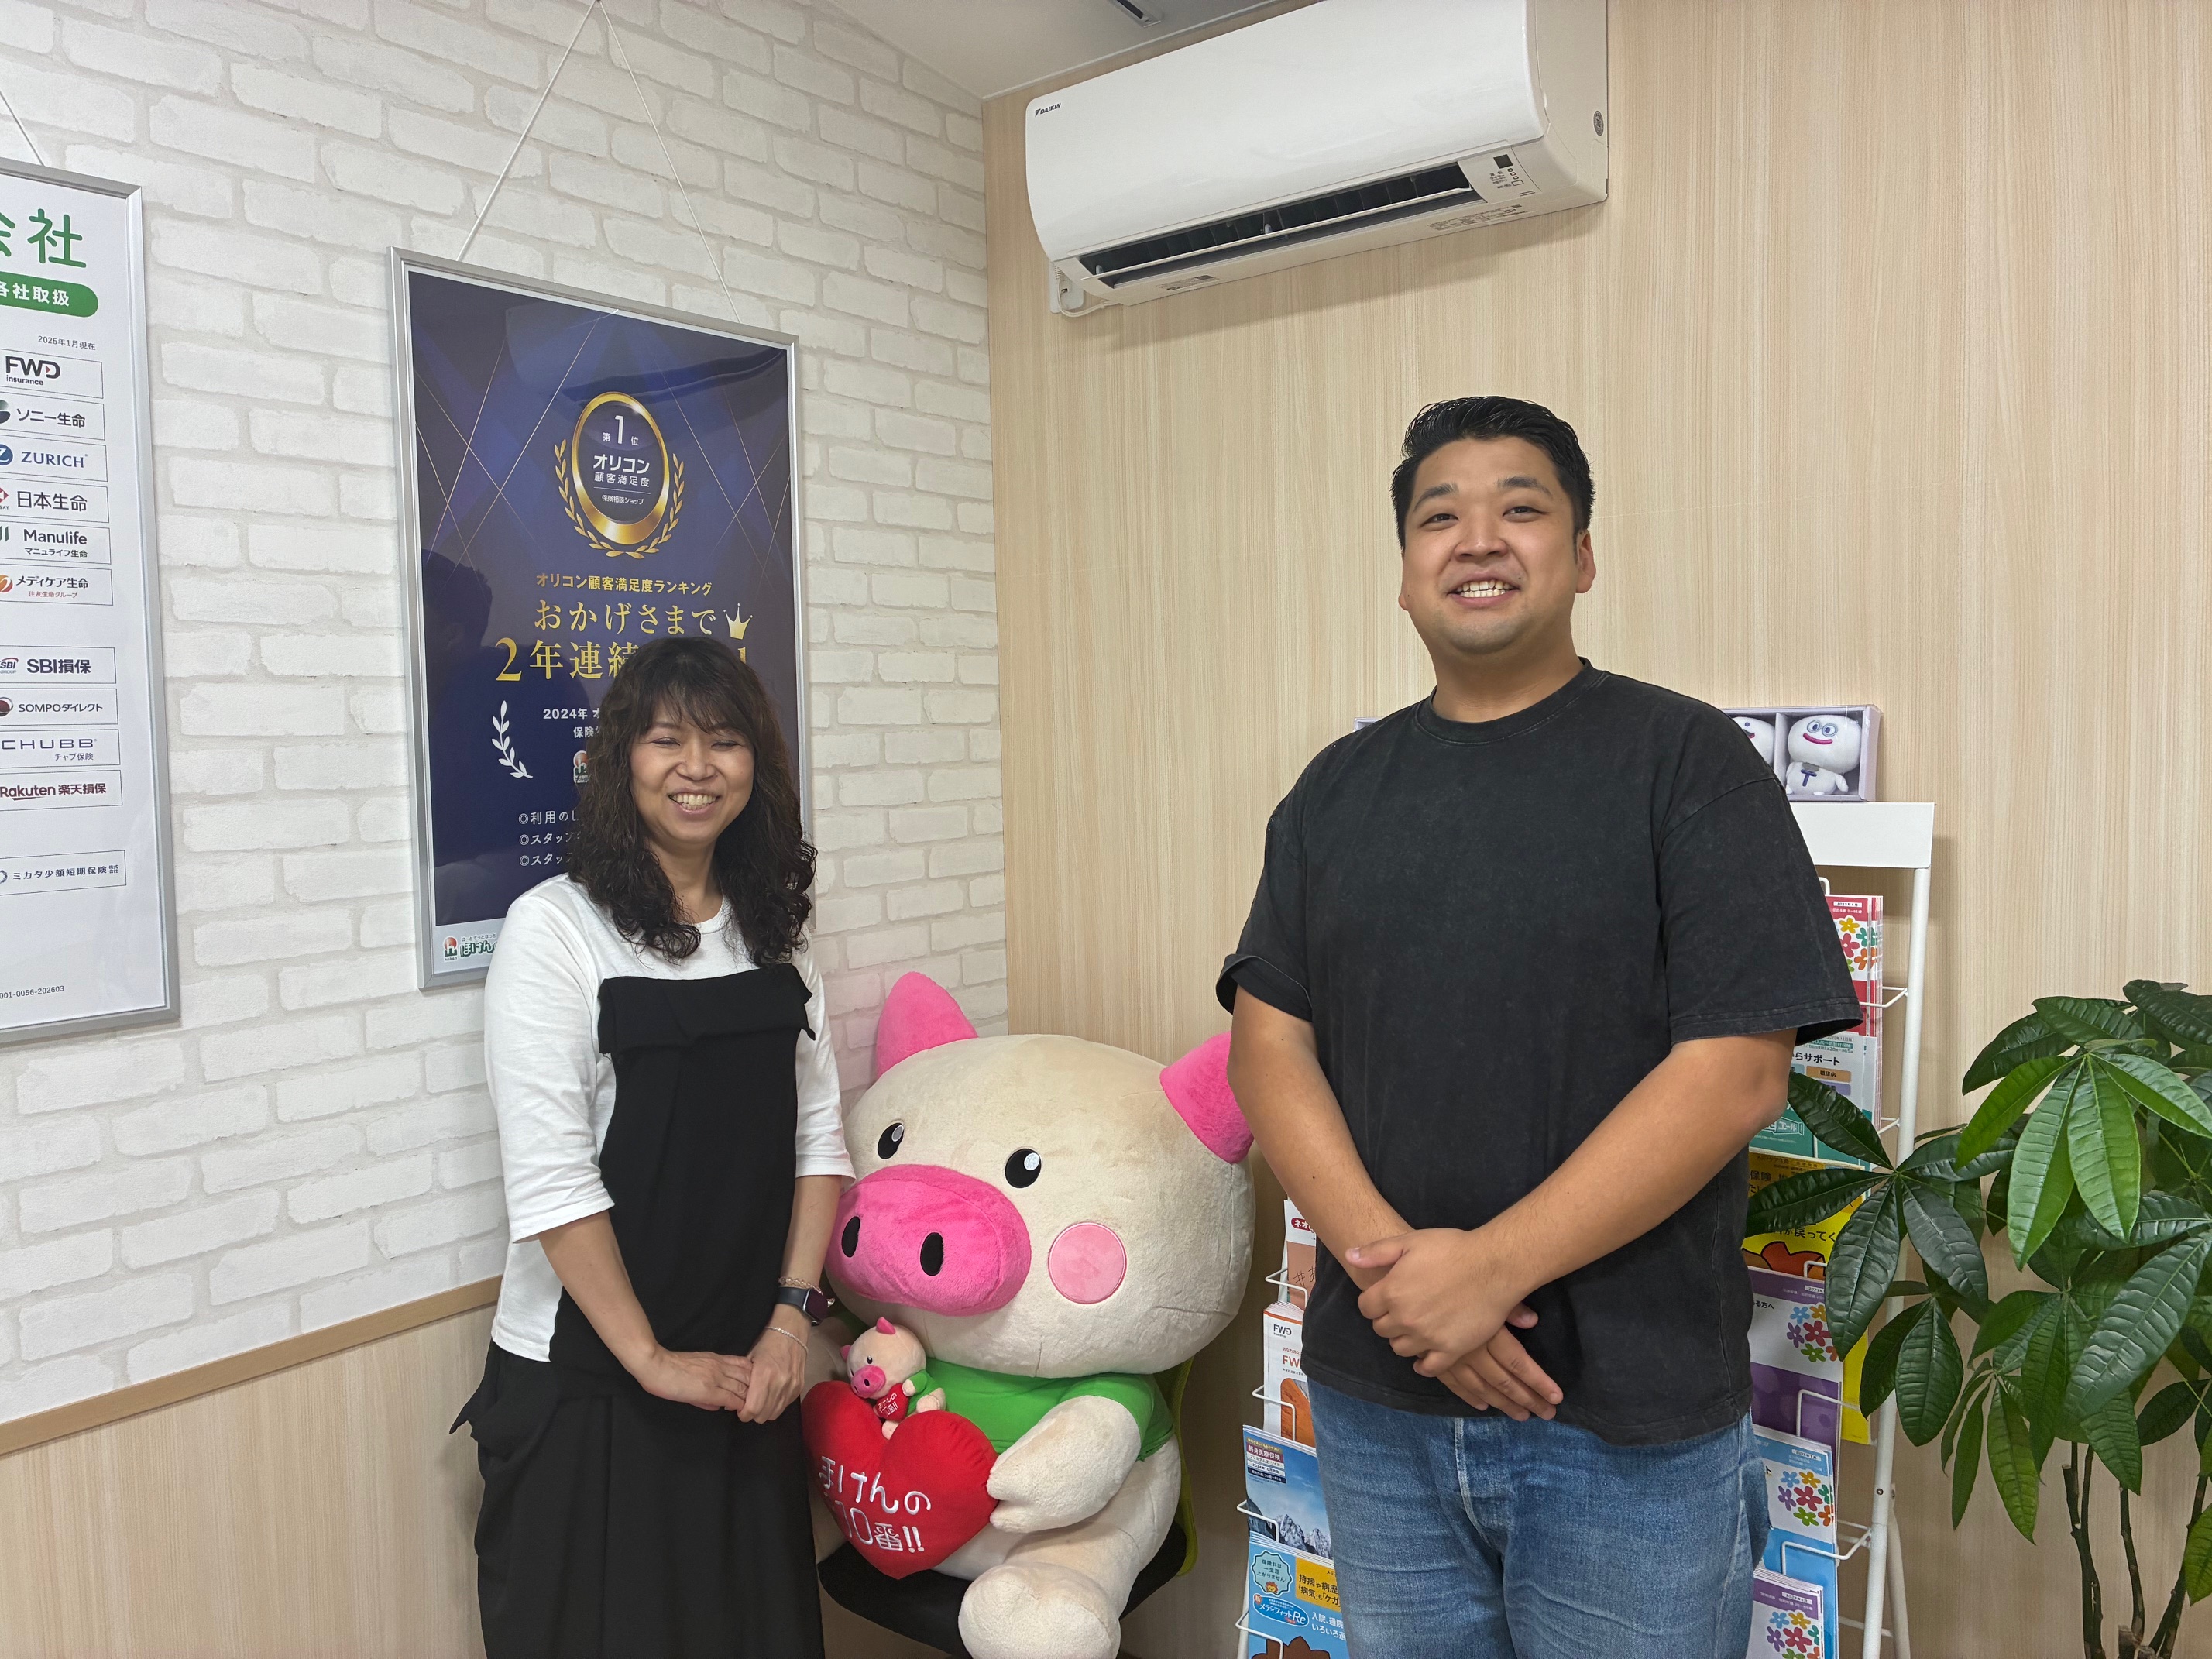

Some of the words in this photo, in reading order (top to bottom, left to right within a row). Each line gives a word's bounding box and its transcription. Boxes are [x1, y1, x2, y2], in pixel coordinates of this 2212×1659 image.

[1040, 102, 1062, 115] DAIKIN
[38, 335, 96, 350] 2025年1月現在
[5, 356, 60, 380] FWD
[6, 375, 44, 386] insurance
[17, 408, 86, 428] ソニー生命
[21, 452, 84, 468] ZURICH
[593, 454, 650, 474] オリコン
[594, 472, 650, 487] 顧客満足度
[17, 490, 88, 512] 日本生命
[602, 494, 644, 505] 保険相談ショップ
[23, 528, 88, 544] Manulife
[25, 547, 88, 558] マニュライフ生命
[15, 575, 89, 589] メディケア生命
[536, 572, 713, 596] オリコン顧客満足度ランキング
[534, 599, 717, 635] おかげさまで
[27, 658, 91, 674] SBI損保
[19, 703, 103, 713] SOMPOダイレクト
[543, 708, 588, 720] 2024年
[2, 739, 94, 750] CHUBB
[54, 753, 94, 761] チャブ保険
[0, 785, 56, 798] Rakuten
[58, 783, 107, 795] 楽天損保
[13, 866, 108, 880] ミカタ少額短期保険
[1792, 1052, 1840, 1066] らサポート
[1273, 1324, 1292, 1335] FWD
